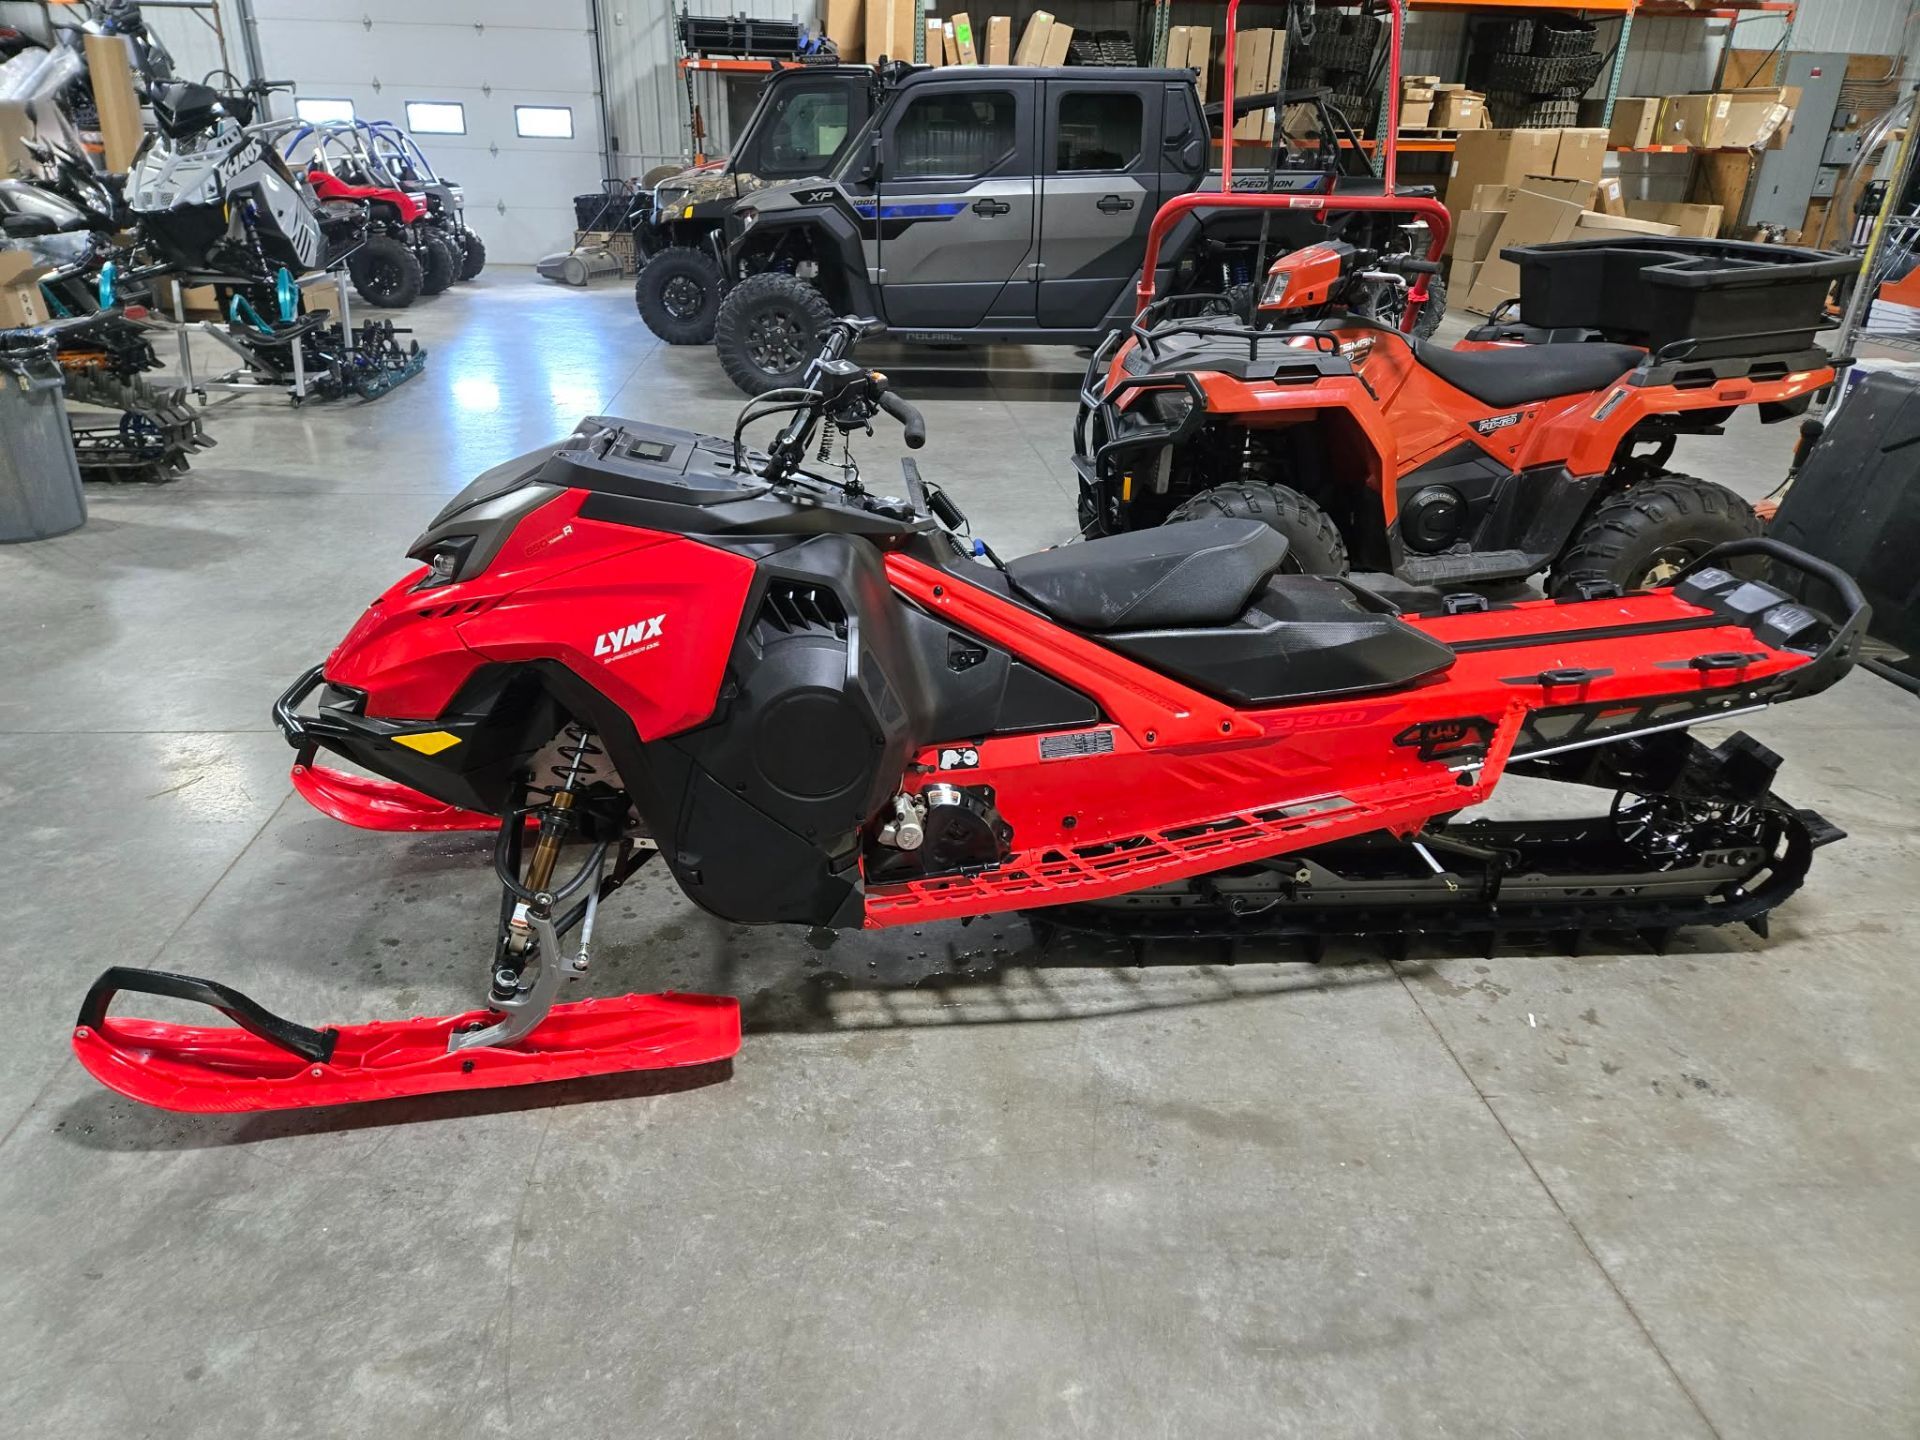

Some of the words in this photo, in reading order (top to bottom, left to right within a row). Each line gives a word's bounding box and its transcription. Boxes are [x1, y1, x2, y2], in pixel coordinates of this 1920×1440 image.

[218, 136, 262, 187] KHAOS
[1231, 177, 1295, 189] XPEDIION
[807, 191, 834, 202] XP
[852, 199, 876, 207] 1000
[1339, 335, 1377, 353] TSMAN
[562, 524, 573, 536] R
[593, 613, 667, 657] LYNX
[1269, 711, 1368, 729] 3900
